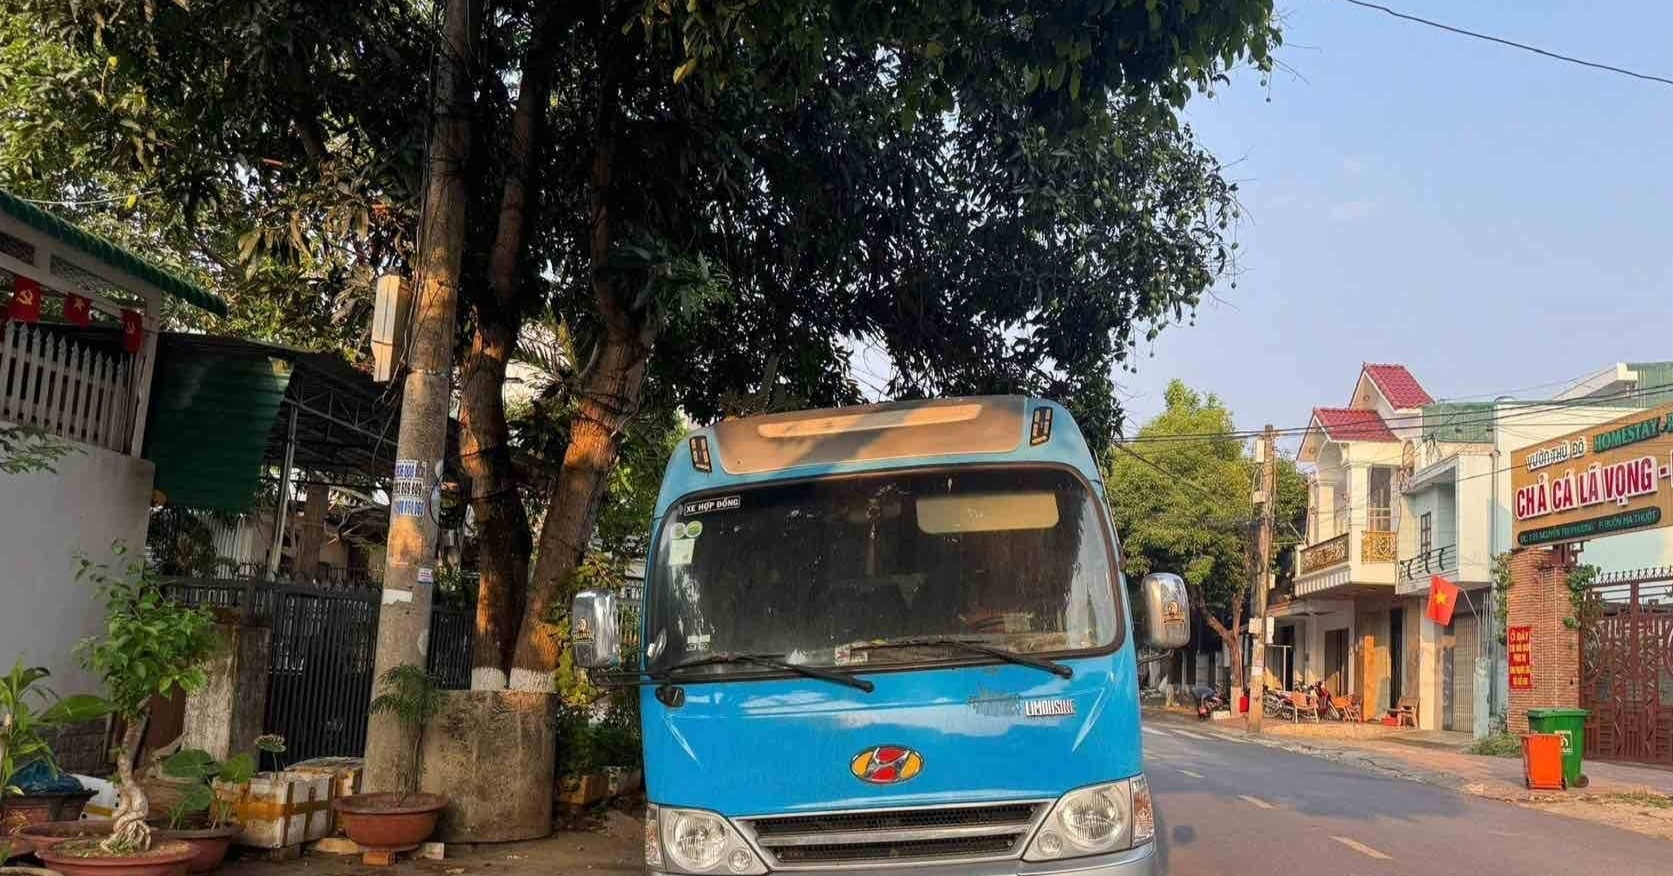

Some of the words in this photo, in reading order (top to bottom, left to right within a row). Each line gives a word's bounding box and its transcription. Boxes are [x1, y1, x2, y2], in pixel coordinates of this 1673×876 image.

[1594, 417, 1660, 450] HOMESTAY
[1516, 474, 1547, 518] CHẢ
[1552, 471, 1574, 510] CÁ
[1579, 466, 1598, 504] LÃ
[1603, 457, 1652, 503] VỌNG
[686, 504, 697, 513] XE
[698, 502, 715, 512] HỢP
[716, 497, 739, 508] ĐỒNG
[1025, 698, 1076, 717] LIMOUSINE
